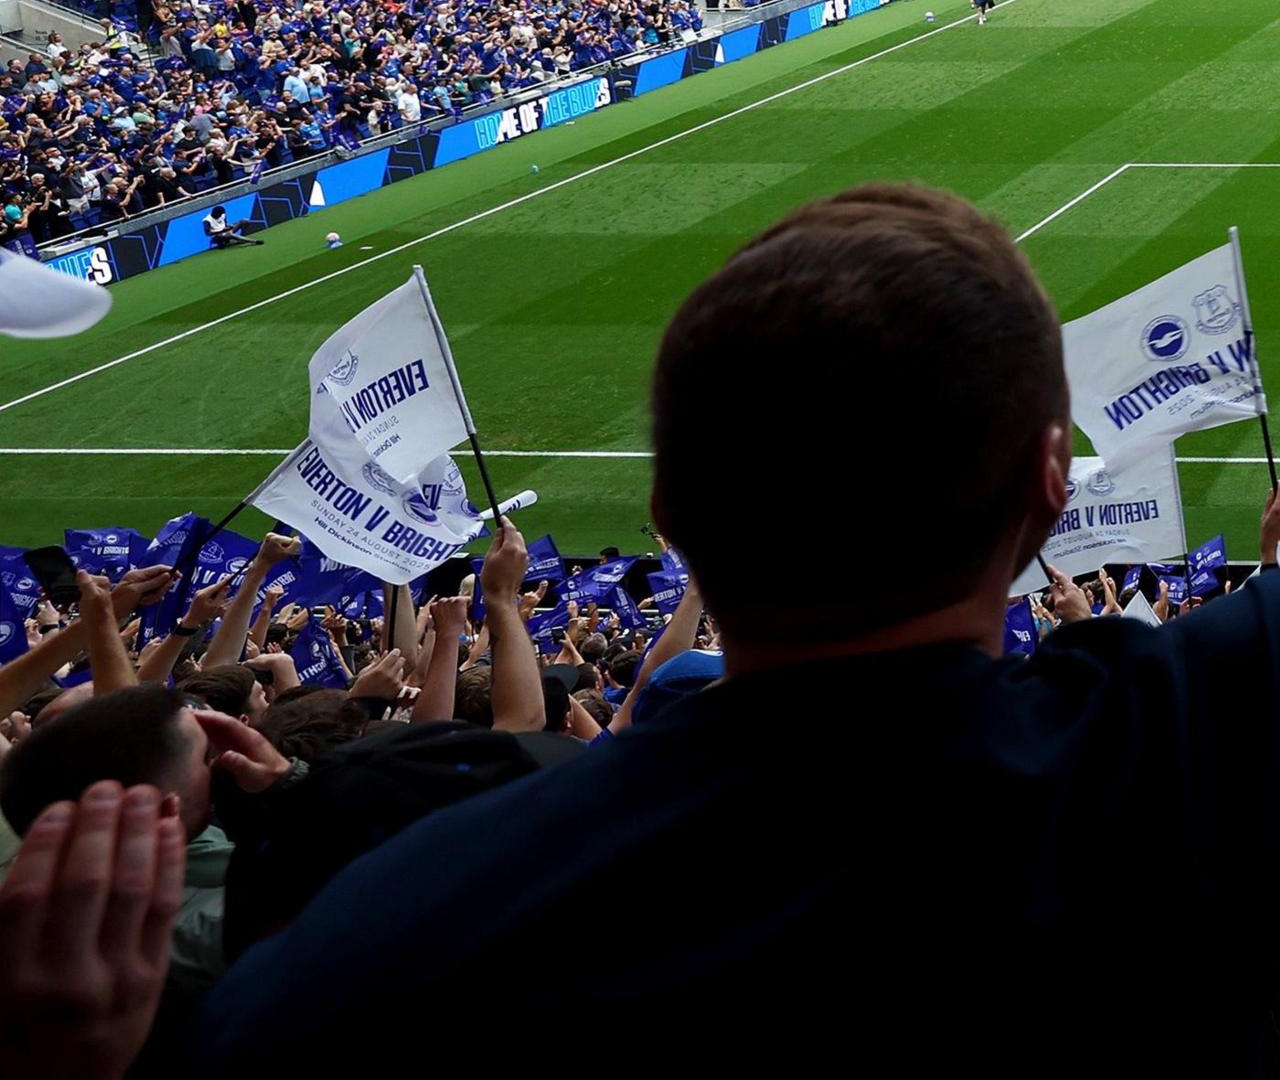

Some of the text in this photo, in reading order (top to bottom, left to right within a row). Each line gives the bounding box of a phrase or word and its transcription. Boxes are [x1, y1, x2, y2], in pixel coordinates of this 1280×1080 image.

[474, 77, 611, 149] HOME OF THE BLUES
[297, 446, 373, 522] EVERTON
[364, 505, 390, 532] V
[310, 499, 432, 570] SUNDAY 24 AUGUST 2025
[314, 516, 328, 532] Hill
[328, 528, 373, 557] Dickinson
